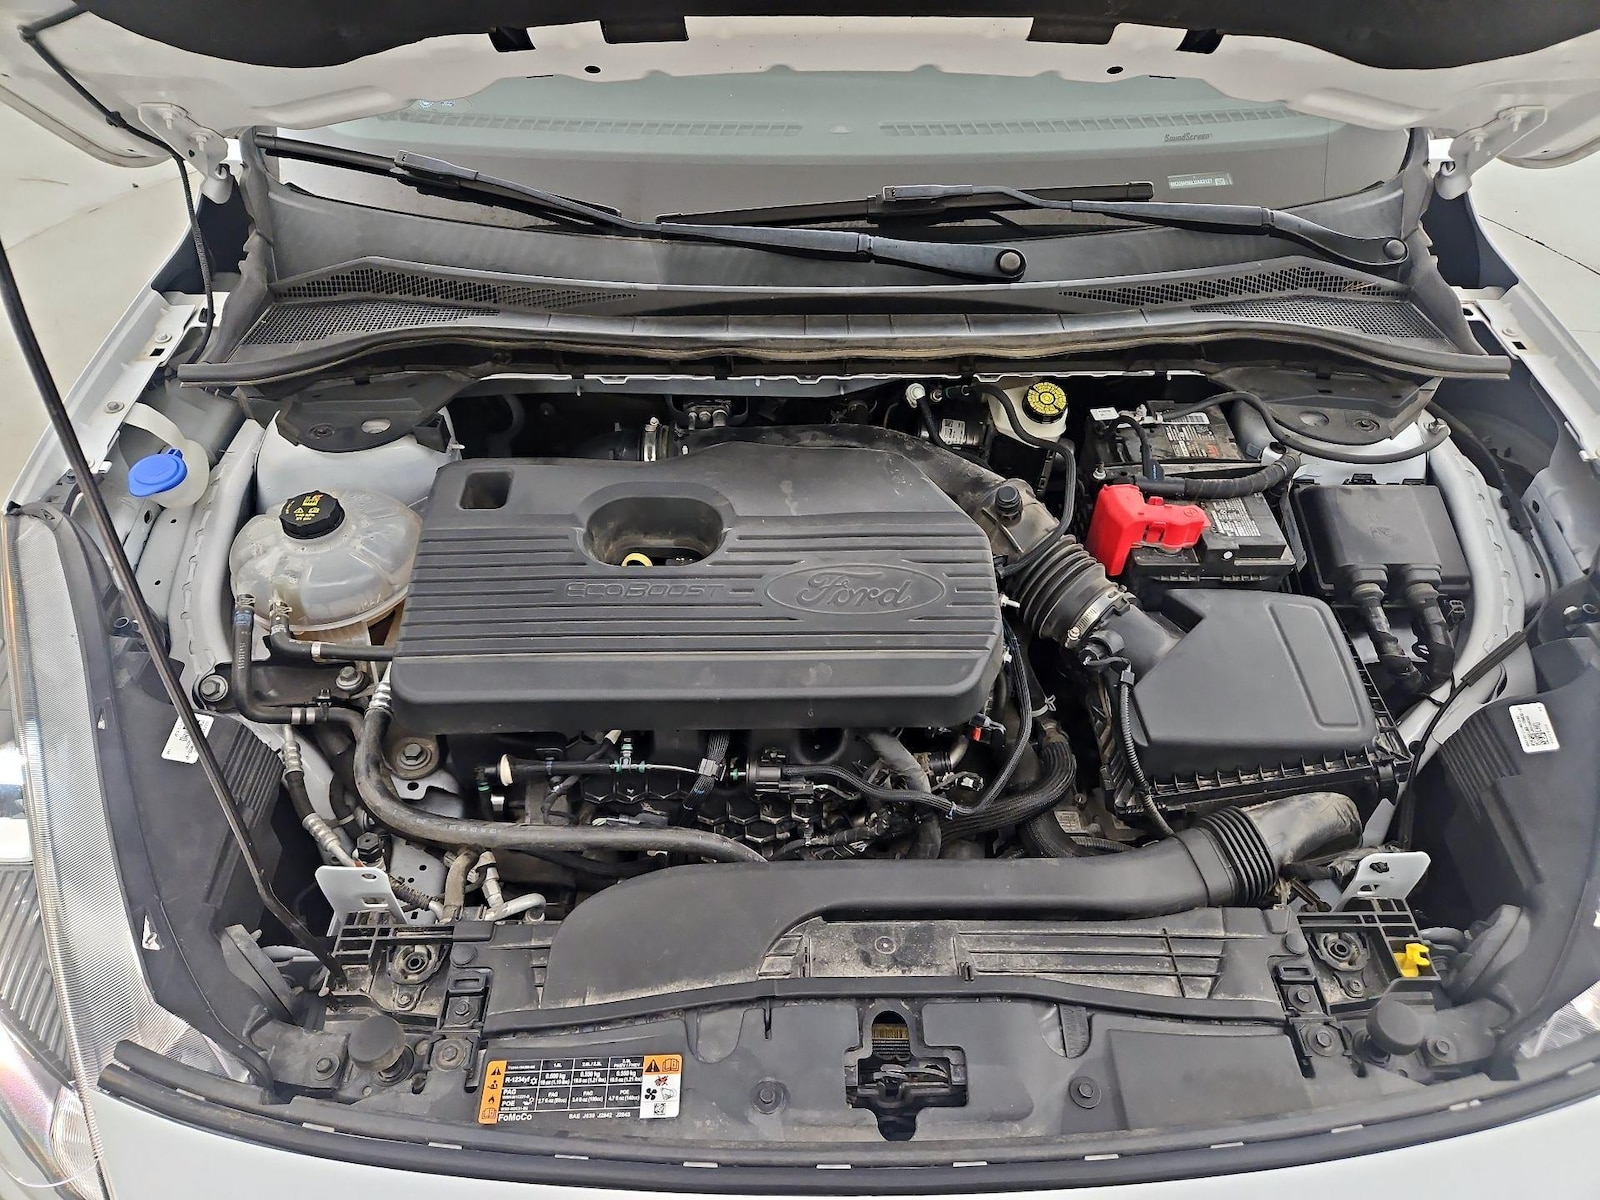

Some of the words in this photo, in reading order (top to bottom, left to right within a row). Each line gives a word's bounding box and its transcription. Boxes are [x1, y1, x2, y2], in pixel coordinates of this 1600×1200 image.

[1164, 132, 1210, 142] SoundScreen
[797, 570, 913, 608] Ford
[498, 1113, 532, 1121] FoMoCo
